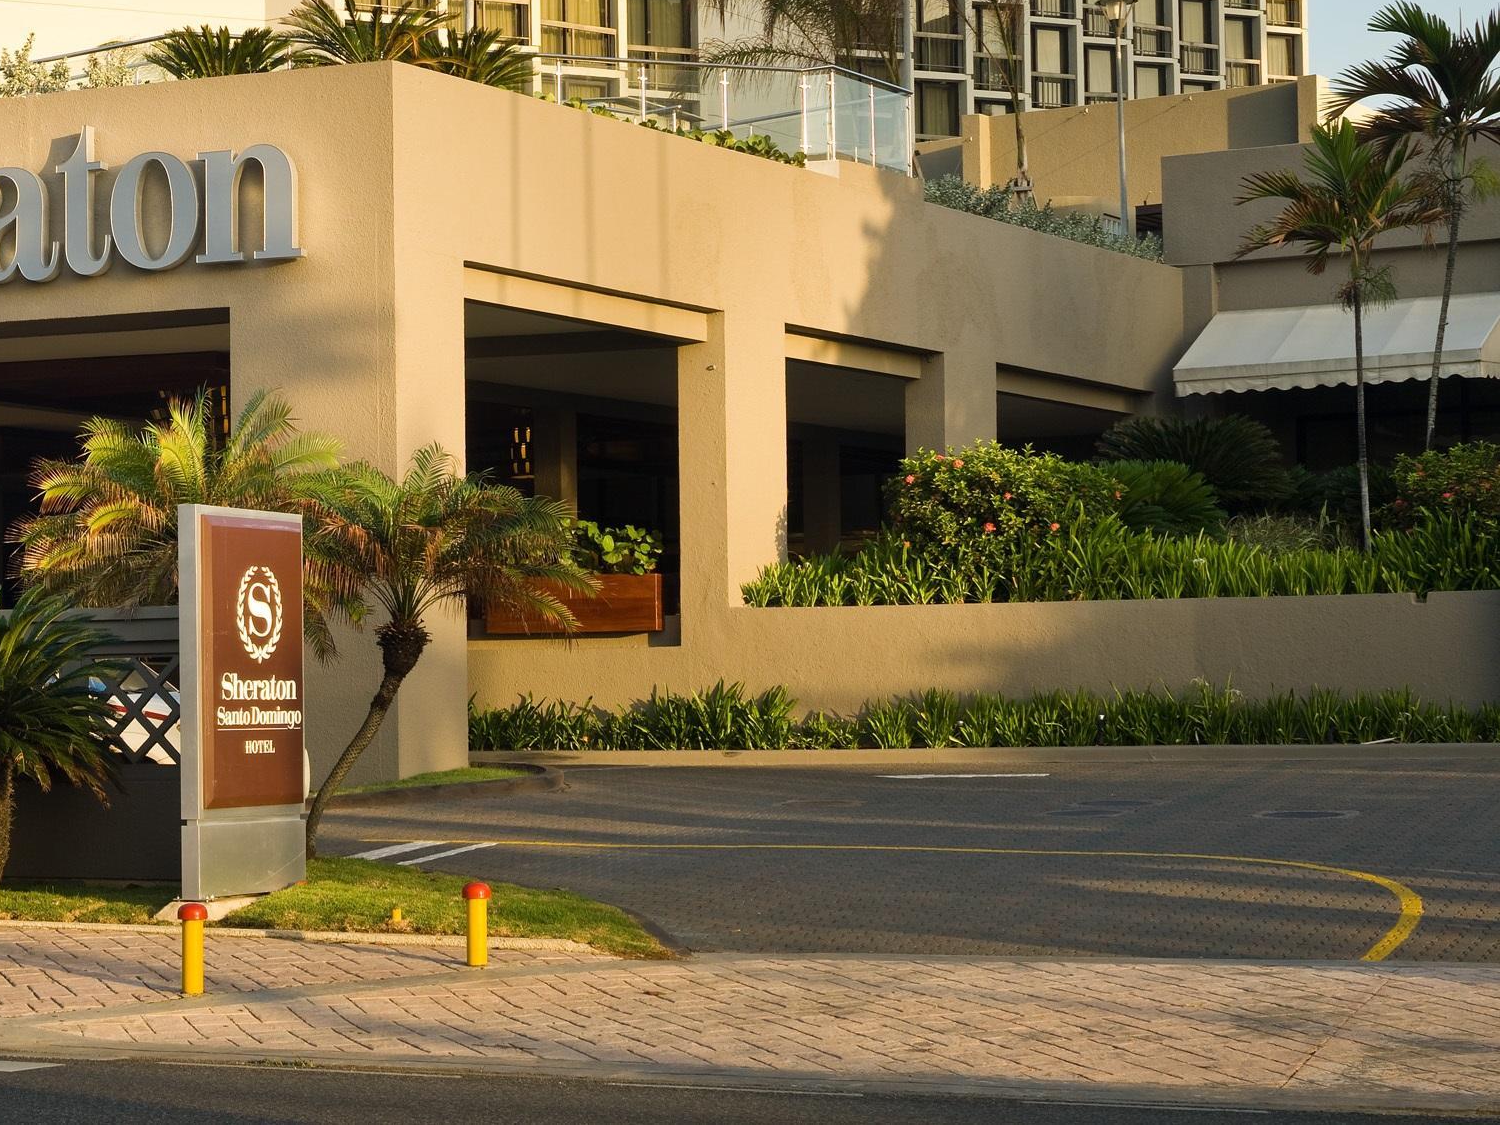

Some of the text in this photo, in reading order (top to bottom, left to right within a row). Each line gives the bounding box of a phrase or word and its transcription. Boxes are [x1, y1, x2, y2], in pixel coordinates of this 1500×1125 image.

[247, 582, 273, 637] S
[221, 672, 297, 701] Sheraton
[216, 705, 302, 730] Santo Domingo
[244, 739, 276, 754] HOTEL
